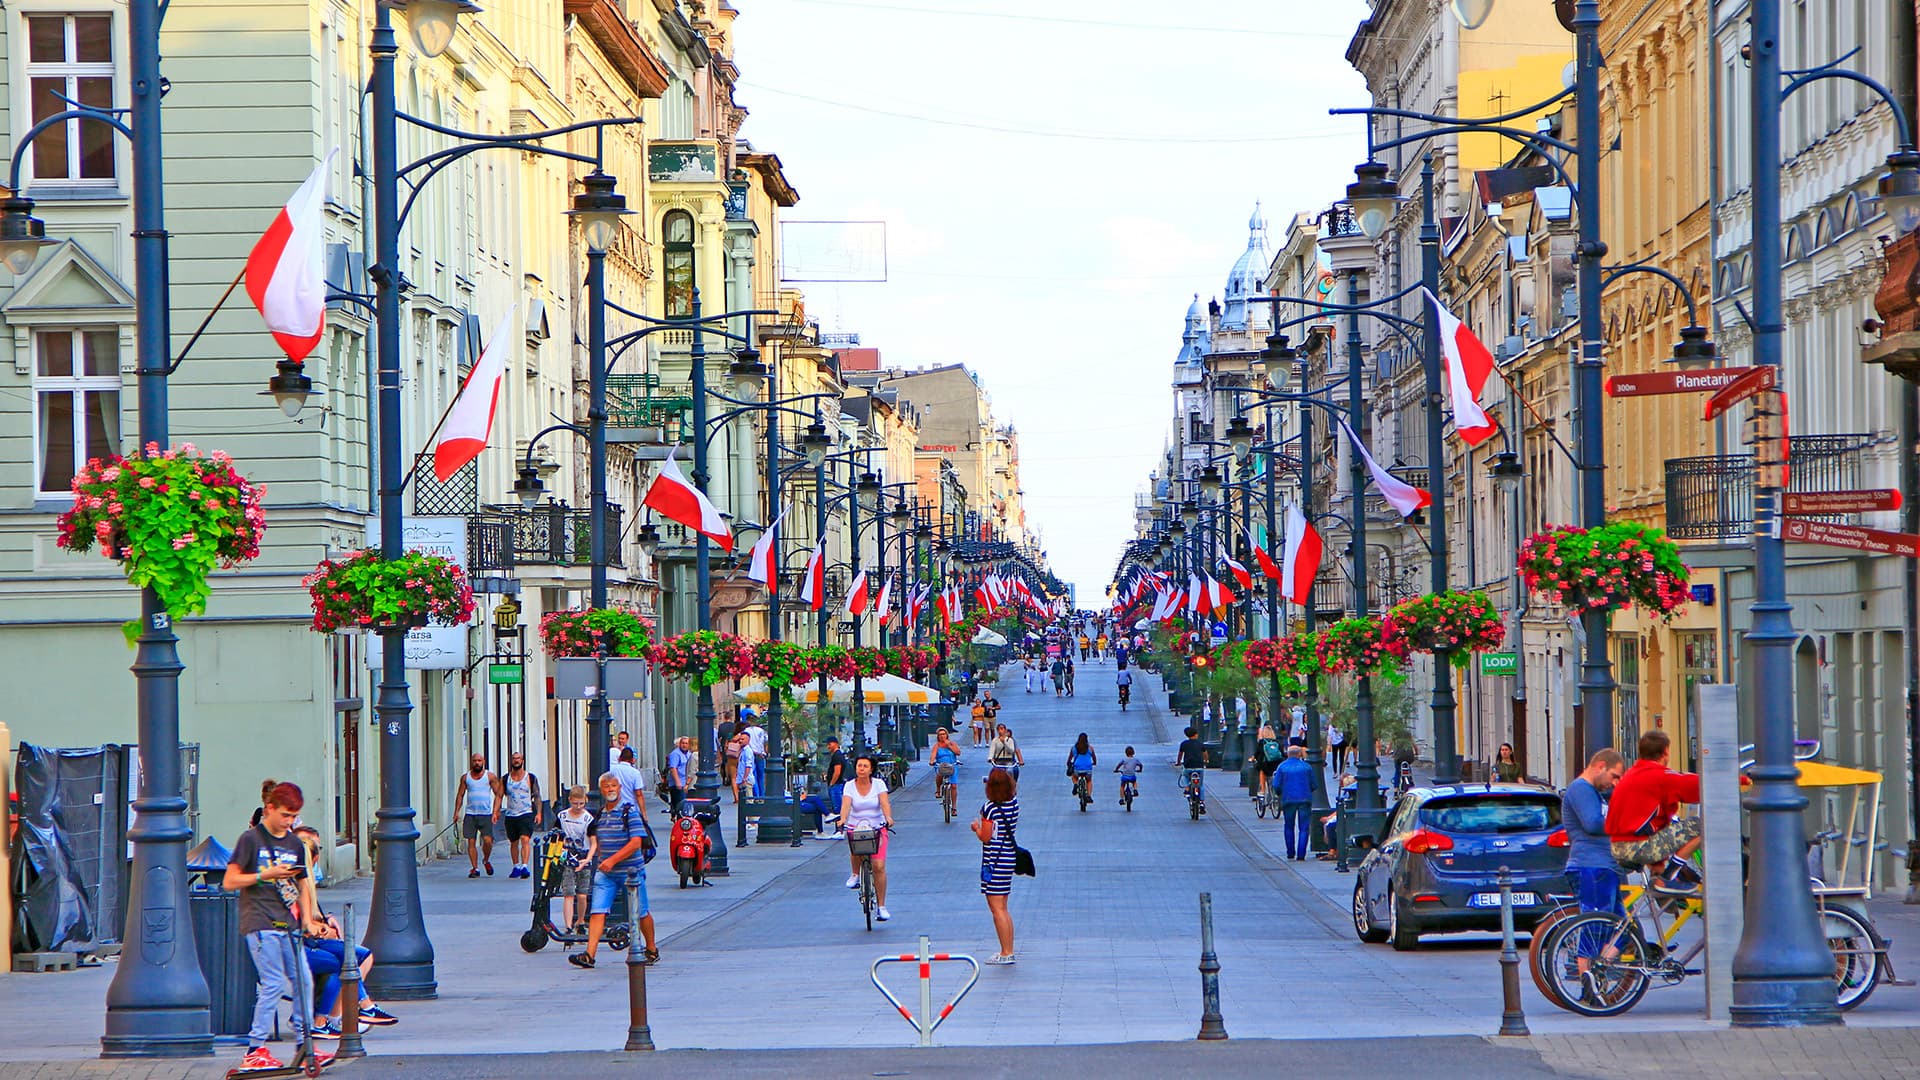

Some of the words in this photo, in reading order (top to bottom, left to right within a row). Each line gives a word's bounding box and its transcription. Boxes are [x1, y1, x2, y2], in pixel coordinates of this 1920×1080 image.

[1616, 384, 1636, 392] 300m
[1810, 523, 1827, 532] Teatr
[1829, 526, 1869, 540] Powszechny
[1808, 532, 1821, 541] The
[1822, 534, 1862, 548] Powszechny
[1865, 540, 1890, 550] Theatre
[1895, 544, 1915, 554] 350m
[411, 545, 453, 555] RAFIA
[404, 631, 432, 640] arsa
[1485, 657, 1516, 667] LODY
[1512, 894, 1532, 905] 8MJ
